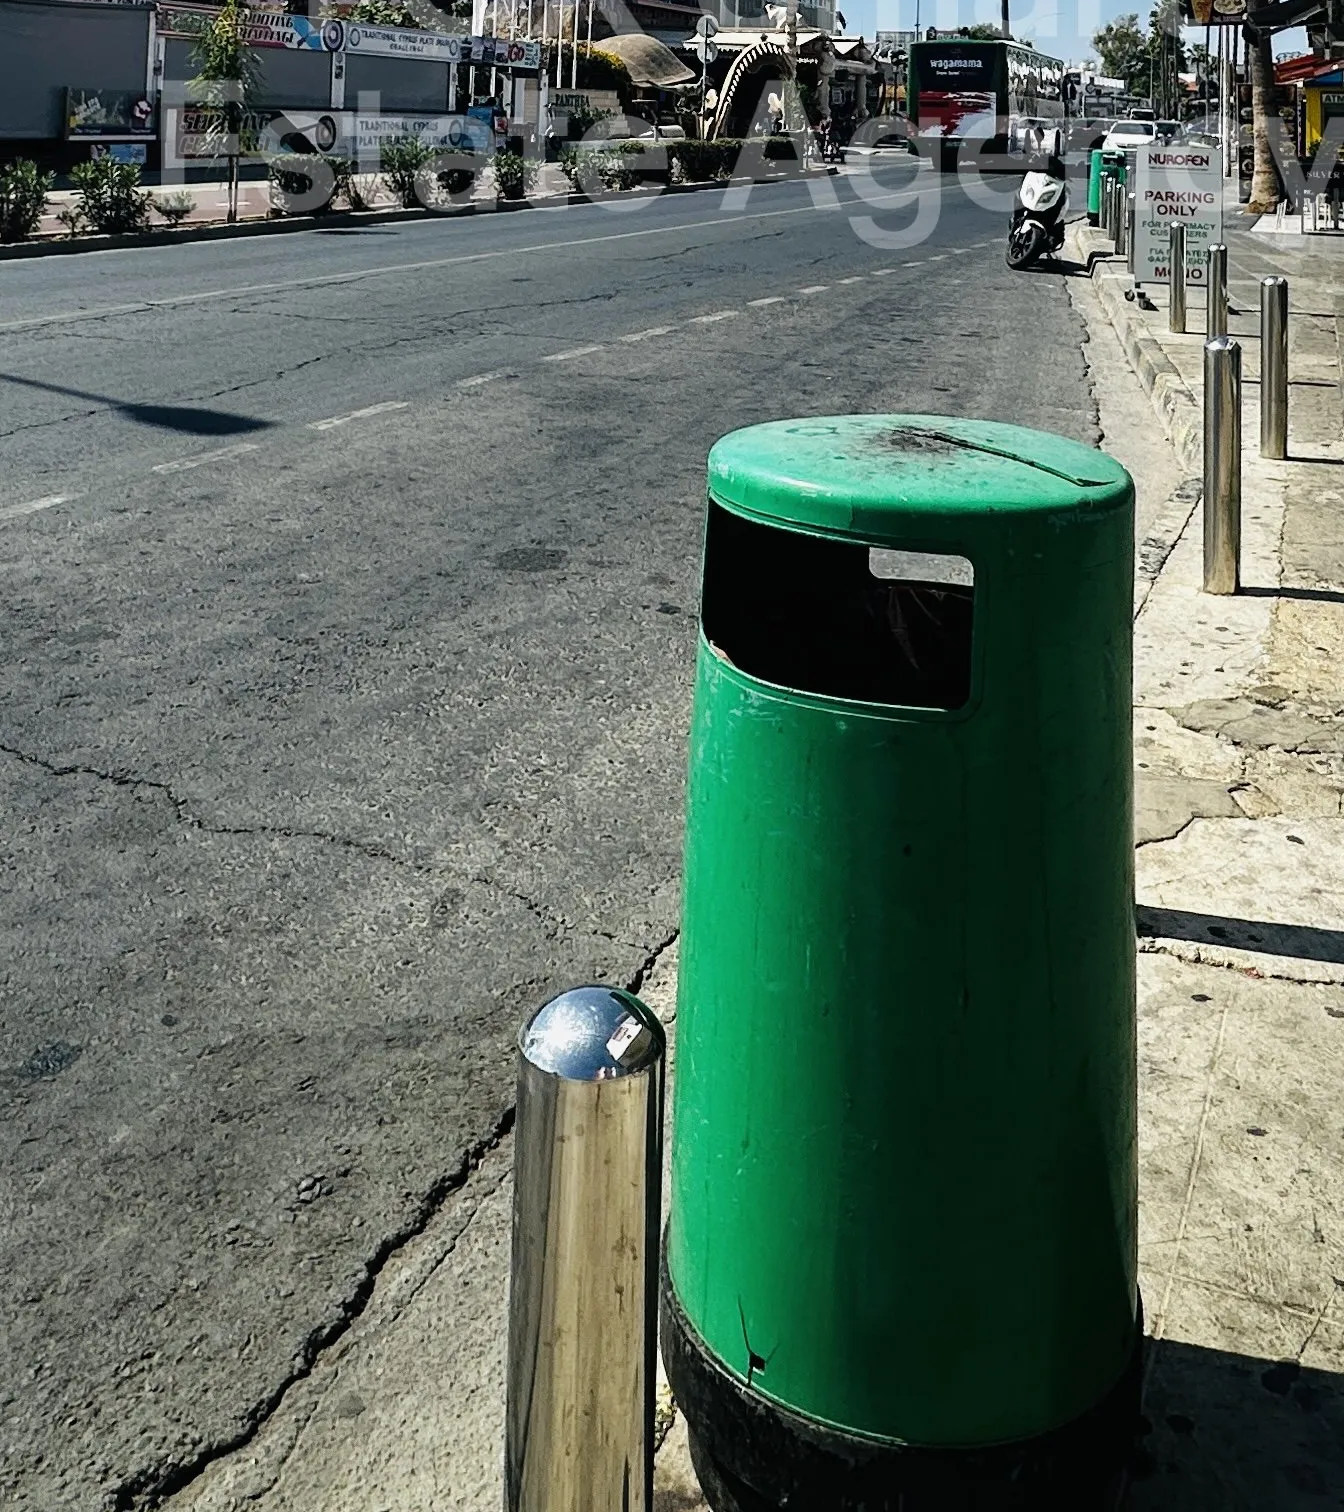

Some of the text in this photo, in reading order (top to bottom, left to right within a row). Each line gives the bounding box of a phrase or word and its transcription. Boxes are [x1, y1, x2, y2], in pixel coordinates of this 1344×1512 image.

[930, 59, 983, 69] wagamama
[1148, 153, 1210, 166] NUROFEN
[1306, 171, 1340, 180] SILVER
[1144, 190, 1215, 204] PARKING
[1156, 204, 1198, 216] ONLY
[1142, 220, 1161, 228] FOR
